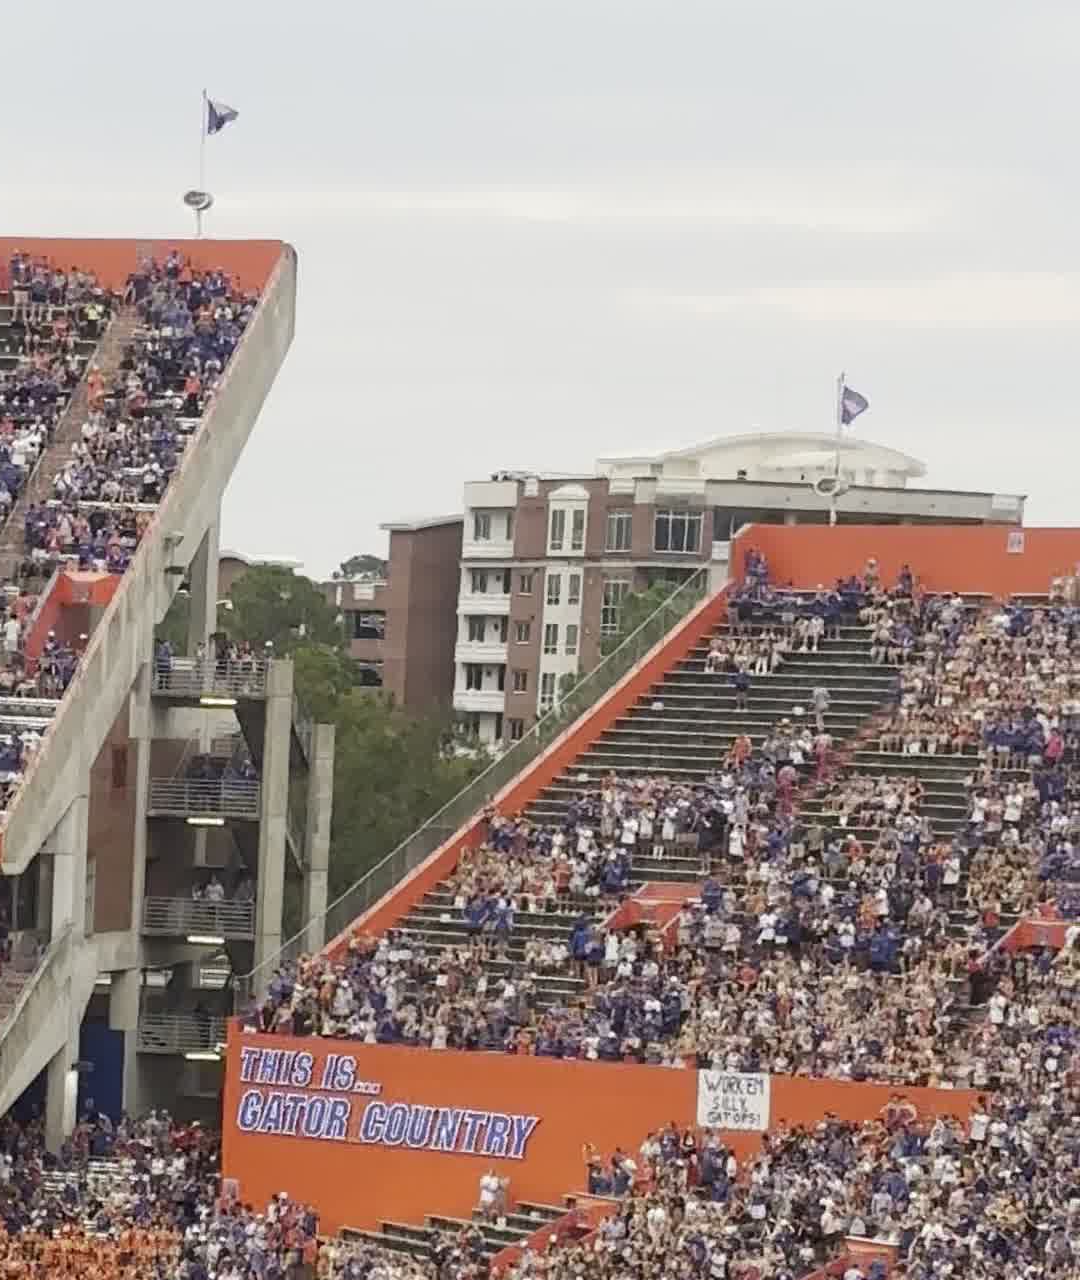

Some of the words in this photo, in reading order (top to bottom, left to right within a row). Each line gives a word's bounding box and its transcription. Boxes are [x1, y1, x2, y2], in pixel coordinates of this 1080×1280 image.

[240, 1046, 314, 1086] THIS
[321, 1054, 381, 1095] IS...
[237, 1089, 352, 1139] GATOR
[360, 1101, 539, 1160] COUNTRY
